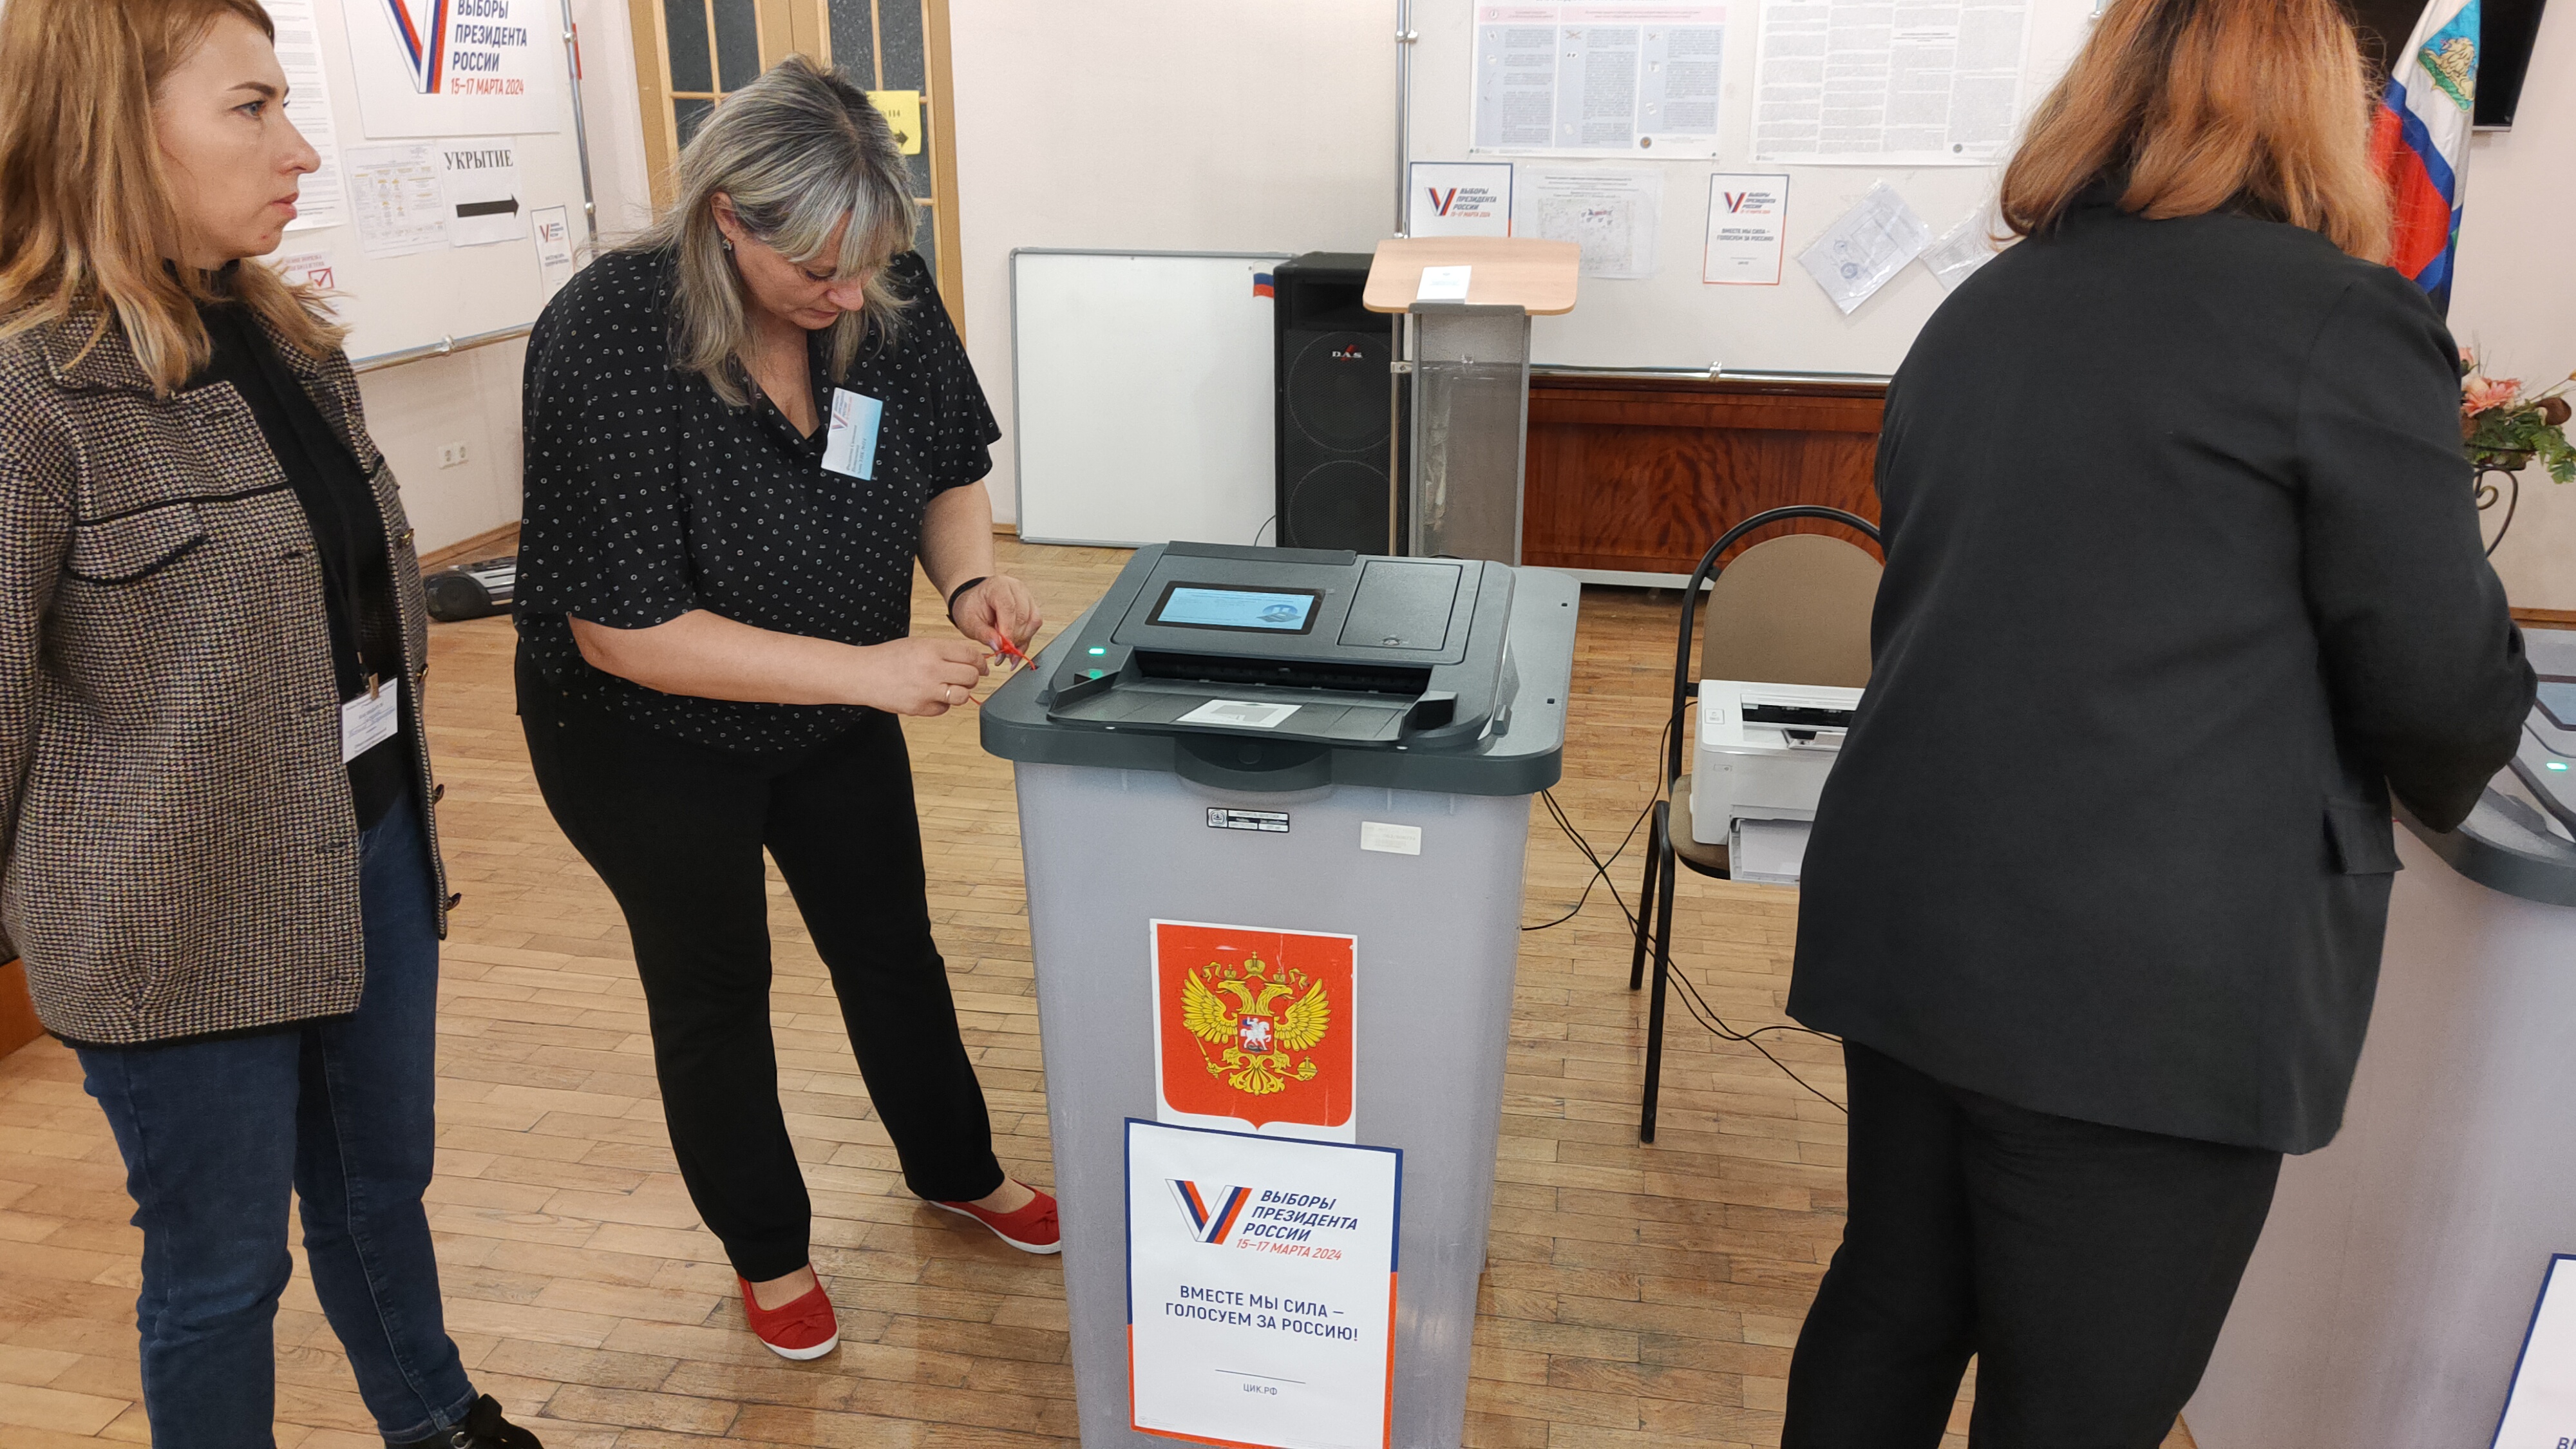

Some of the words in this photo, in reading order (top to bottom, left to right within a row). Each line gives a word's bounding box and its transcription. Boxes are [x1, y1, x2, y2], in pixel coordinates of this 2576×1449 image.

[457, 0, 509, 19] ВЫБОРЫ
[455, 24, 527, 48] ПРЕЗИДЕНТА
[452, 51, 500, 72] РОССИИ
[476, 79, 504, 95] МАРТА
[505, 79, 524, 95] 2024
[444, 149, 513, 171] УКРЫТИЕ
[1260, 1190, 1337, 1210] ВЫБОРЫ
[1251, 1206, 1358, 1230] ПРЕЗИДЕНТА
[1243, 1222, 1312, 1242] РОССИИ
[1269, 1243, 1311, 1257] МАРТА
[1312, 1247, 1343, 1261] 2024
[1180, 1285, 1244, 1306] ВМЕСТЕ
[1249, 1294, 1278, 1310] МЫ
[1284, 1299, 1328, 1318] СИЛА
[1166, 1302, 1251, 1326] ГОЛОСУЕМ
[1256, 1314, 1276, 1329] ЗА
[1282, 1318, 1358, 1341] РОССИЮ!
[1243, 1383, 1278, 1396] ЦИК.РФ
